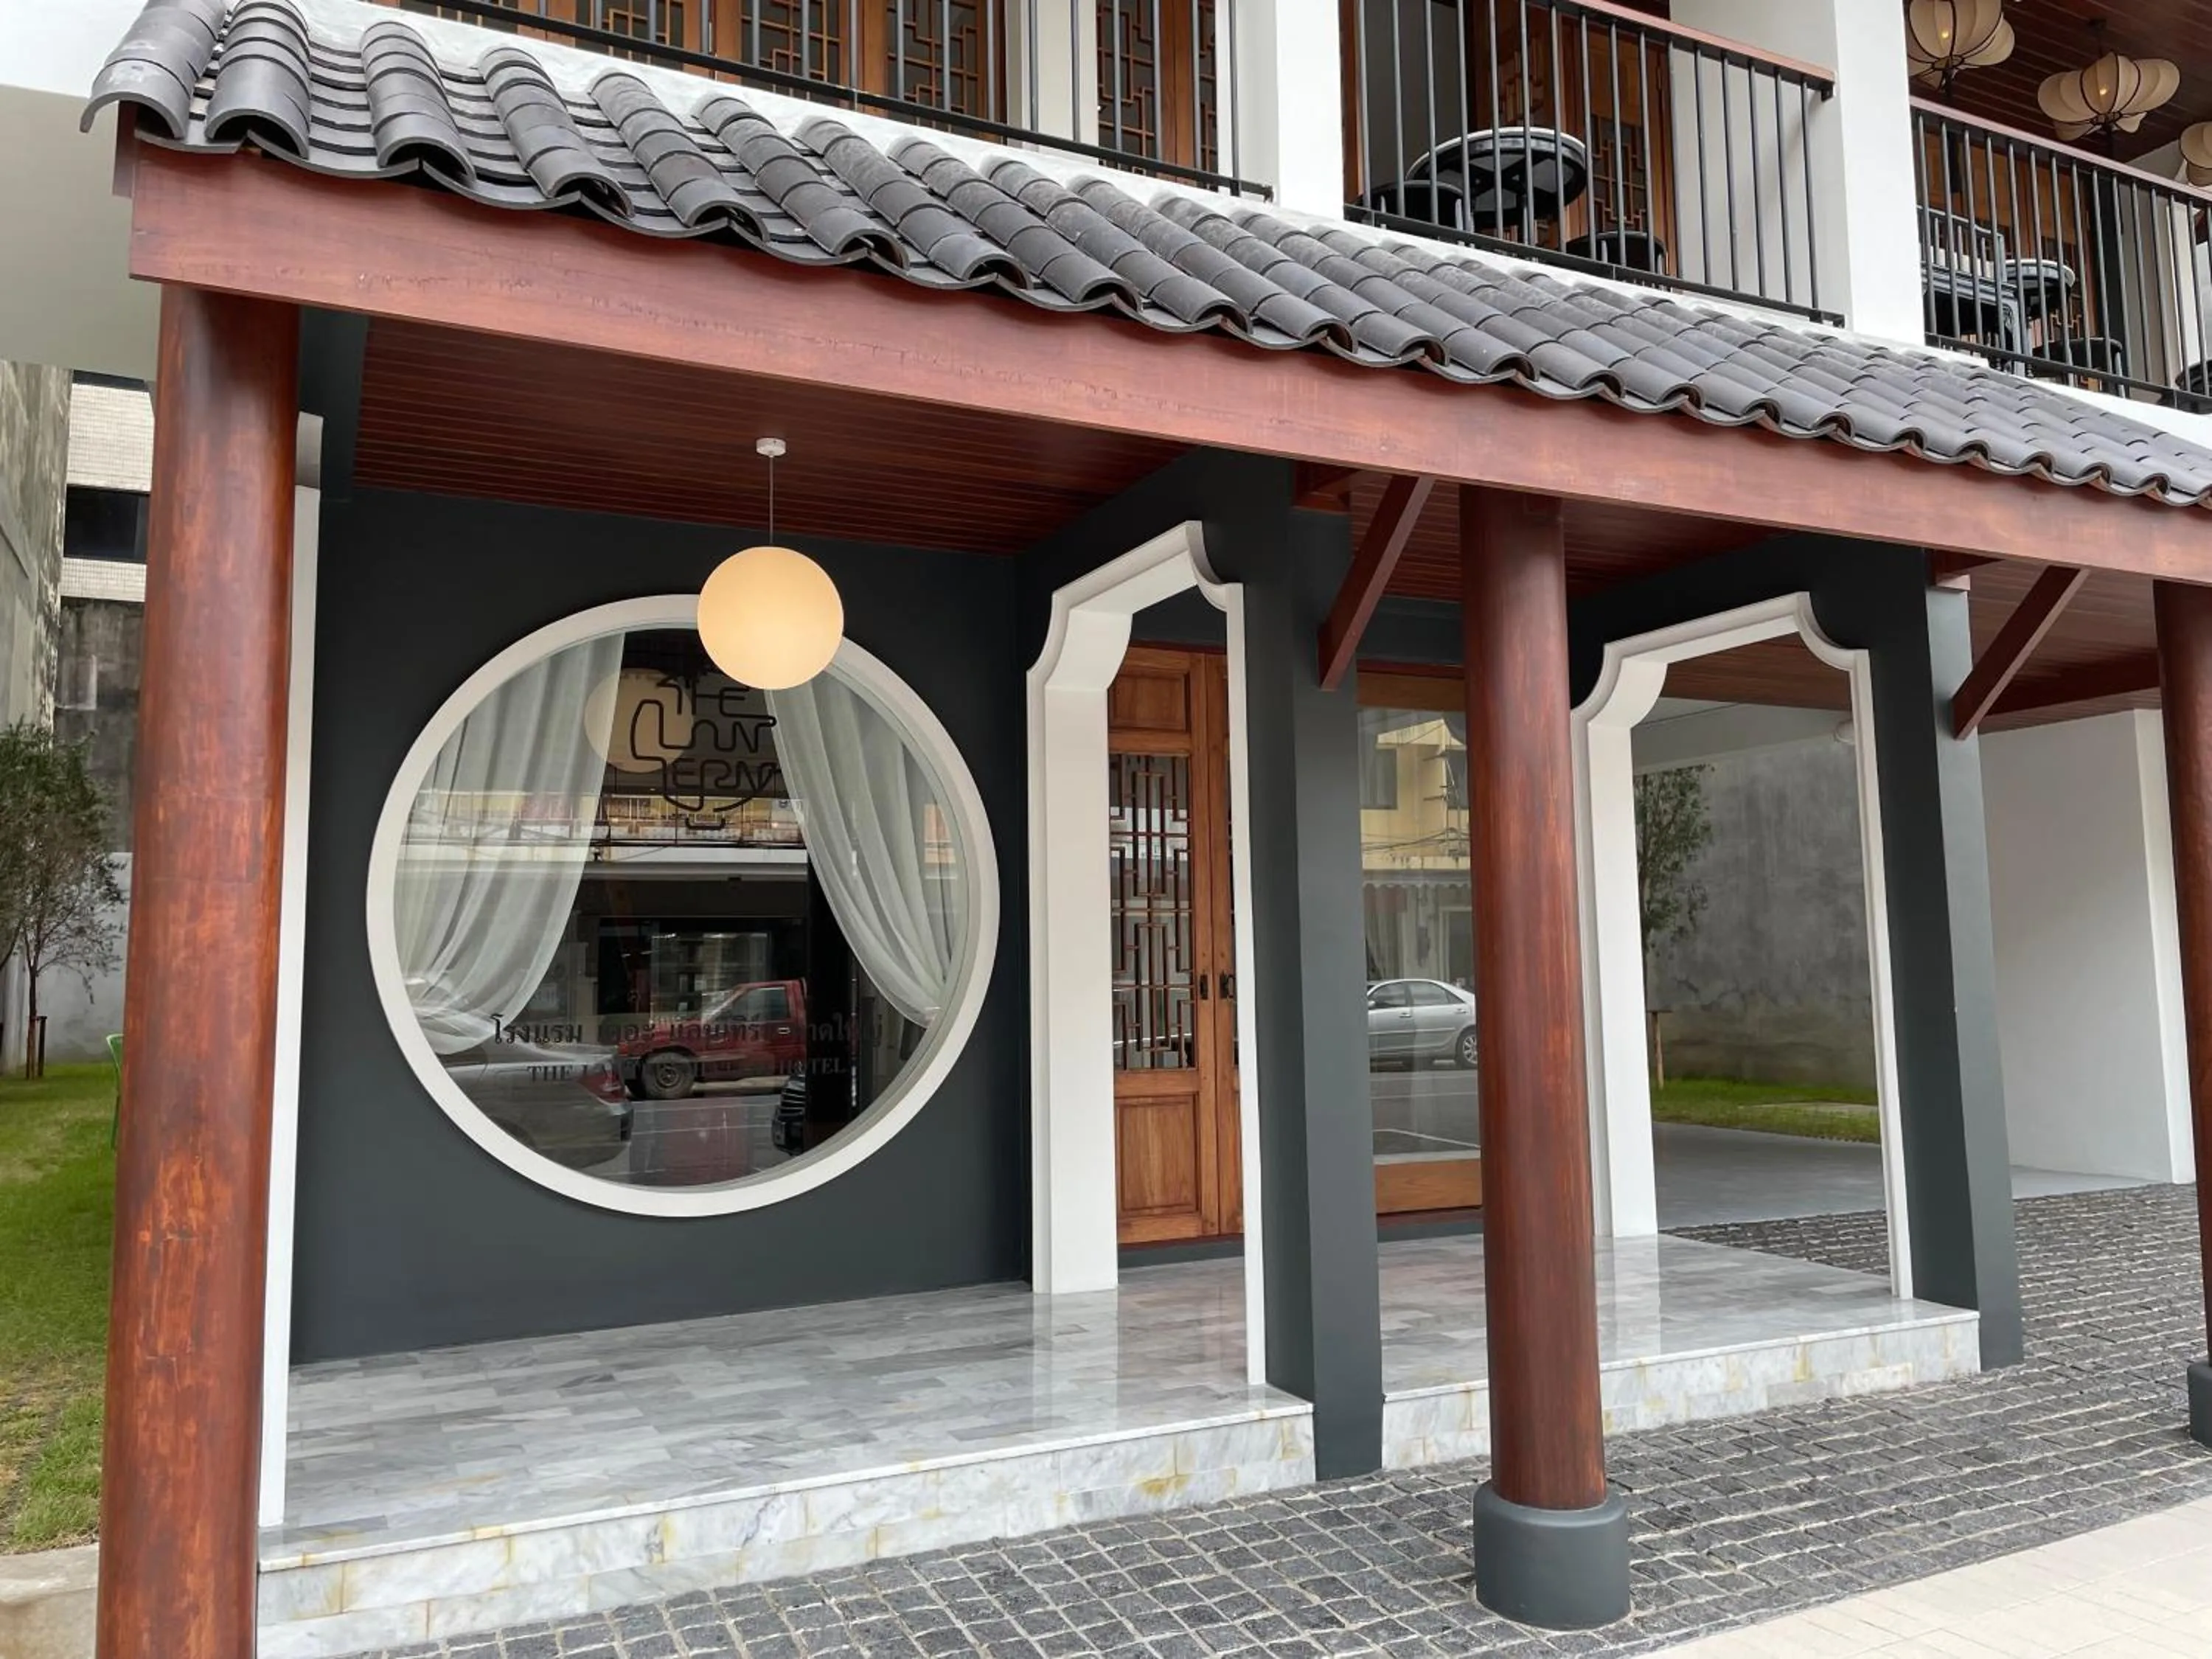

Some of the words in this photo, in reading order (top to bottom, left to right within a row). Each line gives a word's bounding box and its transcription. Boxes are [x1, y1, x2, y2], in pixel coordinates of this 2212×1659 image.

[490, 1014, 582, 1044] โรงแรม
[527, 1064, 574, 1082] THE
